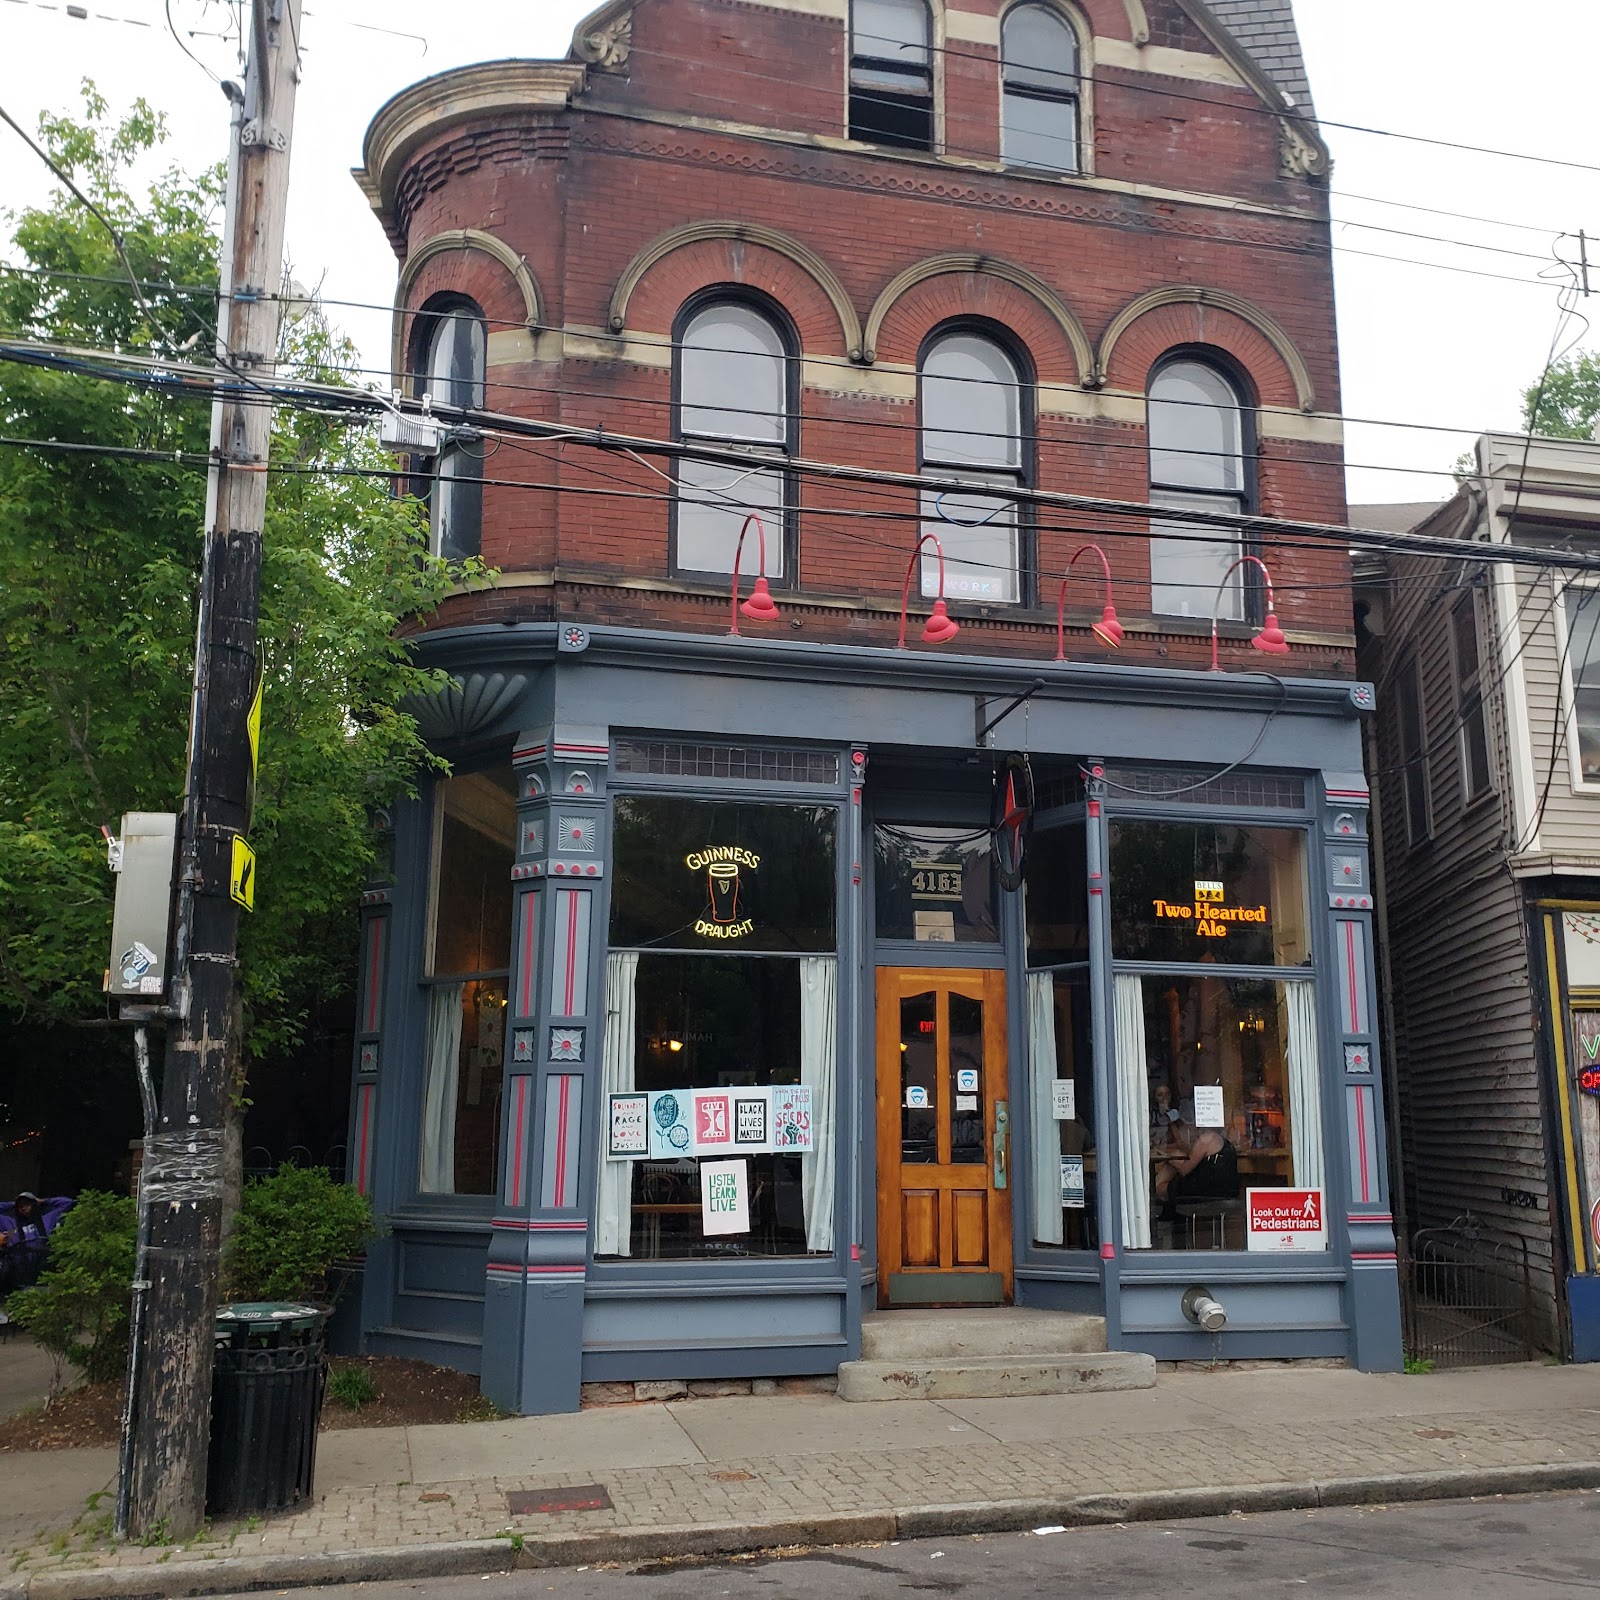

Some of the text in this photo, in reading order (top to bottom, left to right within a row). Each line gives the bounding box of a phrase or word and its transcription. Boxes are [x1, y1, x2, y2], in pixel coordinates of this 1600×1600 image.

[686, 846, 761, 870] GUINNESS
[911, 871, 962, 893] 4163
[1153, 900, 1267, 922] Two Hearted
[695, 918, 754, 938] DRAUGHT
[1196, 919, 1227, 937] Ale
[703, 1102, 723, 1111] GIVE
[739, 1104, 763, 1115] BLACK
[615, 1115, 642, 1126] RAGE
[740, 1117, 763, 1128] LIVES
[775, 1110, 810, 1130] SEEDS
[613, 1130, 641, 1139] LOVE
[739, 1129, 763, 1140] MATTER
[709, 1173, 736, 1188] LISTEN
[709, 1186, 737, 1200] LEARN
[709, 1198, 737, 1213] LIVE
[1252, 1207, 1303, 1217] Look Out for
[1252, 1217, 1320, 1230] Pedestrians
